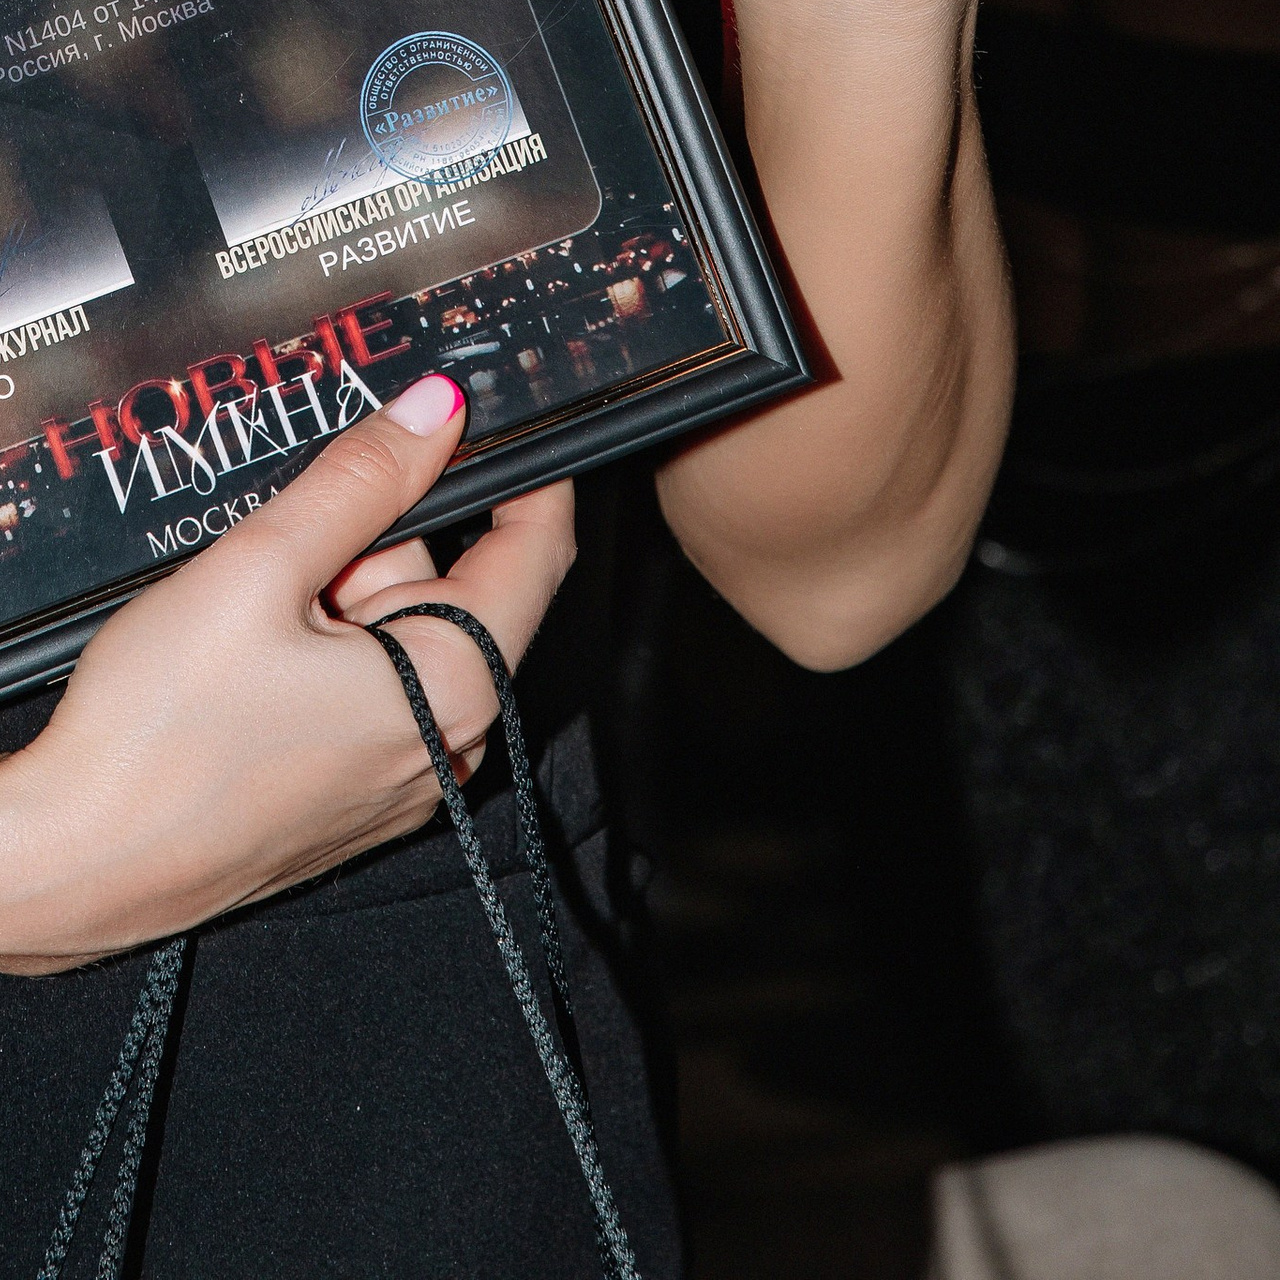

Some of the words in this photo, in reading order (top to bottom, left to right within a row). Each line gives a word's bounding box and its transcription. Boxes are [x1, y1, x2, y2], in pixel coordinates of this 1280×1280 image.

[4, 8, 88, 58] N1404
[92, 0, 122, 25] от
[92, 32, 113, 52] г.
[369, 55, 399, 110] ОБЩЕСТВО
[400, 49, 407, 58] С
[380, 51, 474, 100] ОТВЕТСТВЕННОСТЬЮ
[394, 133, 548, 213] ОРГАНИЗАЦИЯ
[318, 199, 475, 277] РАЗВИТИЕ
[41, 290, 411, 481] НОВЫЕ
[91, 359, 383, 515] ИМЕНА
